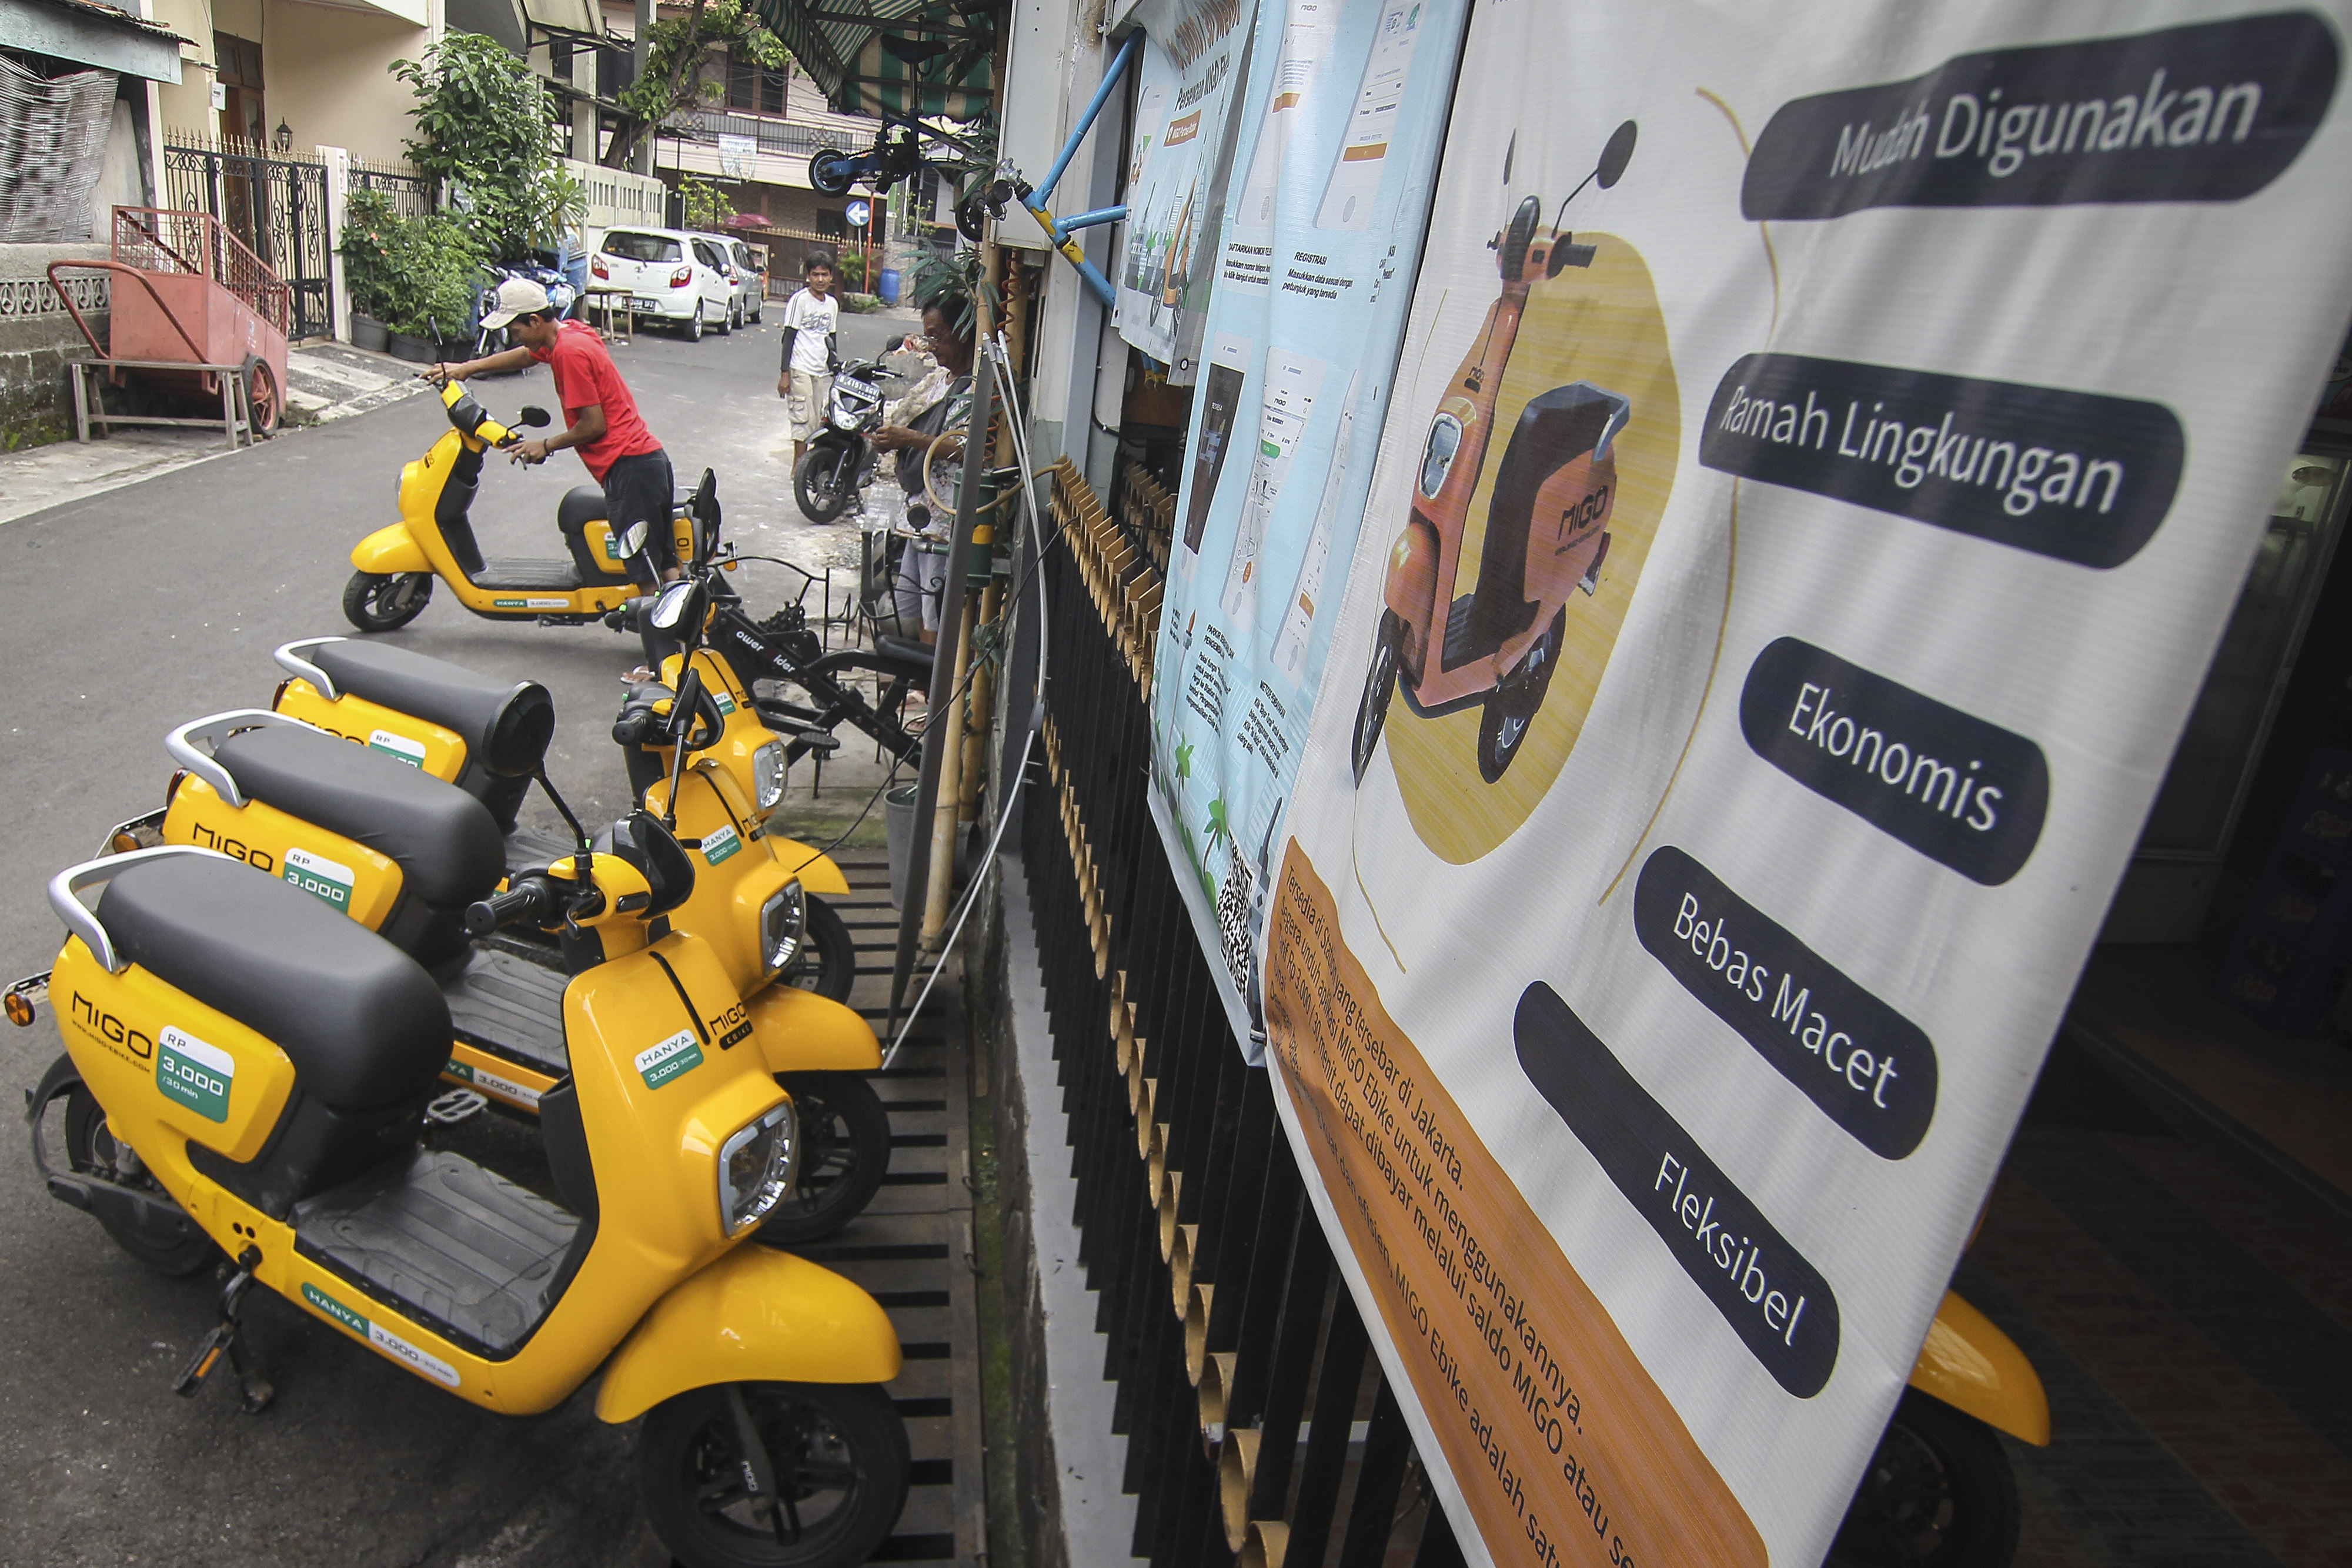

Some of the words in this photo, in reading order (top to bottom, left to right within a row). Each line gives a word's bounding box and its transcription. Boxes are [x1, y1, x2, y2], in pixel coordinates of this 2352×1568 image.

[1830, 99, 1930, 178] Mudah
[1936, 69, 2263, 178] Digunakan
[1287, 268, 1315, 282] Masukkan
[1315, 274, 1326, 284] data
[1294, 252, 1328, 265] REGISTRASI
[1281, 282, 1307, 295] petunjuk
[1305, 287, 1319, 299] yang
[1719, 385, 1829, 450] Ramah
[1837, 400, 2125, 517] Lingkungan
[1558, 485, 1608, 541] MIGO
[736, 631, 764, 651] ower
[773, 654, 796, 673] ider
[376, 735, 390, 744] RP
[1788, 683, 2003, 832] Ekonomis
[193, 823, 273, 873] MIGO
[703, 829, 730, 848] HANYA
[292, 854, 310, 865] RP
[288, 871, 345, 902] 3.000
[709, 1002, 747, 1036] MIGO
[1673, 892, 1766, 1003] Bebas
[1770, 974, 1897, 1111] Macet
[72, 991, 153, 1059] MIGO
[167, 1033, 187, 1048] RP
[1285, 865, 1317, 925] Tersedia
[1315, 914, 1325, 939] di
[1333, 978, 1358, 1027] yang
[1355, 1008, 1400, 1086] tersebar
[1398, 1077, 1414, 1108] di
[1411, 1098, 1463, 1191] Jakarta.
[642, 1036, 689, 1065] HANYA
[162, 1056, 224, 1097] 3.000
[478, 1075, 518, 1095] 3.000
[649, 1061, 679, 1082] 3.000
[1281, 895, 1301, 945] Segera
[1301, 937, 1321, 988] unduh
[1318, 980, 1340, 1041] aplikasi
[1337, 1027, 1365, 1083] MIGO
[1362, 1071, 1394, 1135] Ebike
[1394, 1126, 1434, 1198] untuk
[1434, 1187, 1583, 1436] menggunakannya.
[1287, 951, 1295, 981] Rp
[1294, 968, 1312, 1015] 3.000
[1308, 1003, 1316, 1027] /
[1312, 1012, 1322, 1042] 30
[1318, 1037, 1337, 1090] menit
[1335, 1079, 1365, 1141] dapat
[1366, 1131, 1414, 1212] dibayar
[1414, 1206, 1469, 1299] melalui
[1466, 1293, 1511, 1372] saldo
[1513, 1360, 1563, 1455] MIGO
[1563, 1454, 1609, 1540] atau
[1653, 1151, 1808, 1346] Fleksibel
[309, 1290, 364, 1330] HANYA
[1339, 1156, 1358, 1201] dan
[1357, 1195, 1394, 1279] efisien,
[1395, 1263, 1428, 1336] MIGO
[1429, 1328, 1468, 1412] Ebike
[1469, 1409, 1525, 1518] adalah
[1525, 1513, 1561, 1568] sat
